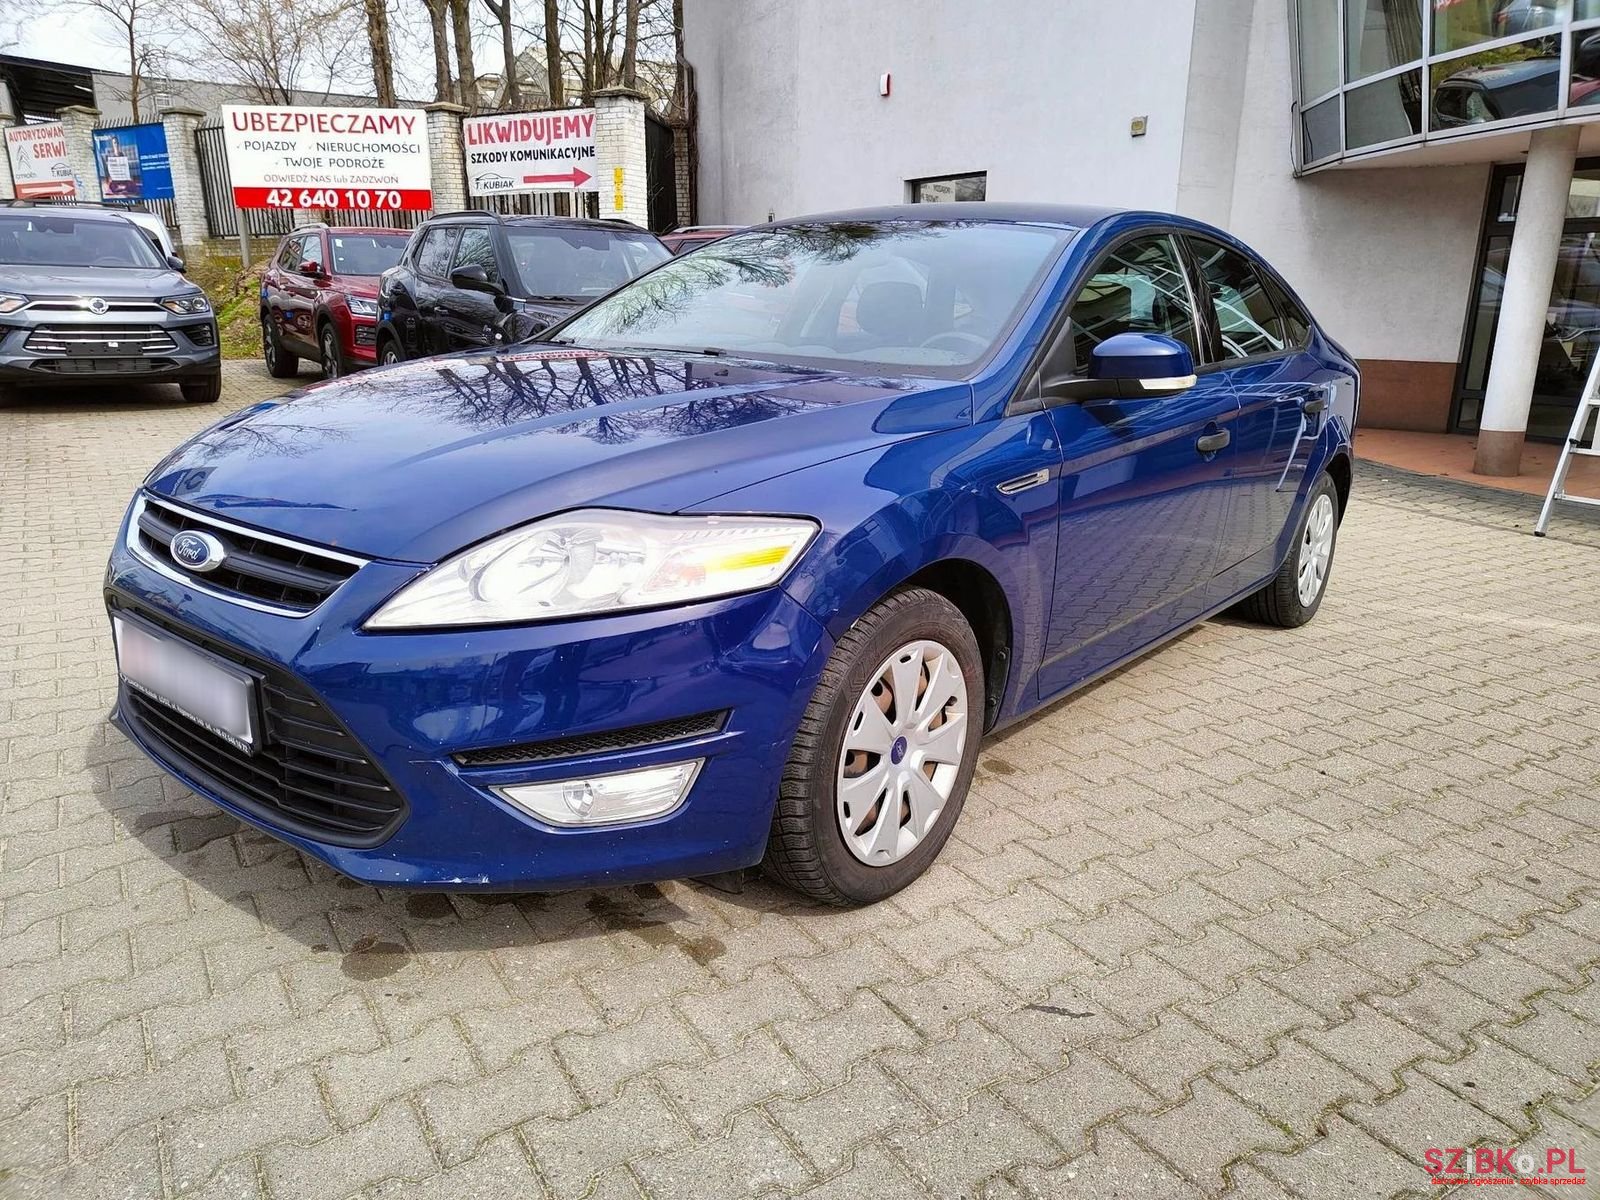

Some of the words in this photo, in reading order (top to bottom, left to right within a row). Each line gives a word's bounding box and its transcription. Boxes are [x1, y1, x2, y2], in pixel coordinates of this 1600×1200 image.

[232, 112, 416, 135] UBEZPIECZAMY
[467, 113, 595, 146] LIKWIDUJEMY
[9, 126, 65, 142] AUTORYZOWAN
[33, 141, 67, 159] SERWI
[244, 141, 297, 152] POJAZDY
[316, 141, 421, 154] NIERUCHOMOŚCI
[470, 149, 508, 164] SZKODY
[510, 145, 596, 163] KOMUNIKACYJNE
[284, 157, 323, 168] TWOJE
[329, 156, 385, 169] PODRÓŻE
[264, 173, 309, 183] ODWIEDŹ
[310, 175, 331, 183] NAS
[334, 174, 348, 184] lub
[483, 180, 515, 190] KUBIAK
[266, 189, 293, 207] 42
[299, 189, 339, 208] 640
[345, 190, 371, 208] 10
[375, 190, 402, 208] 70
[178, 538, 201, 560] Ford
